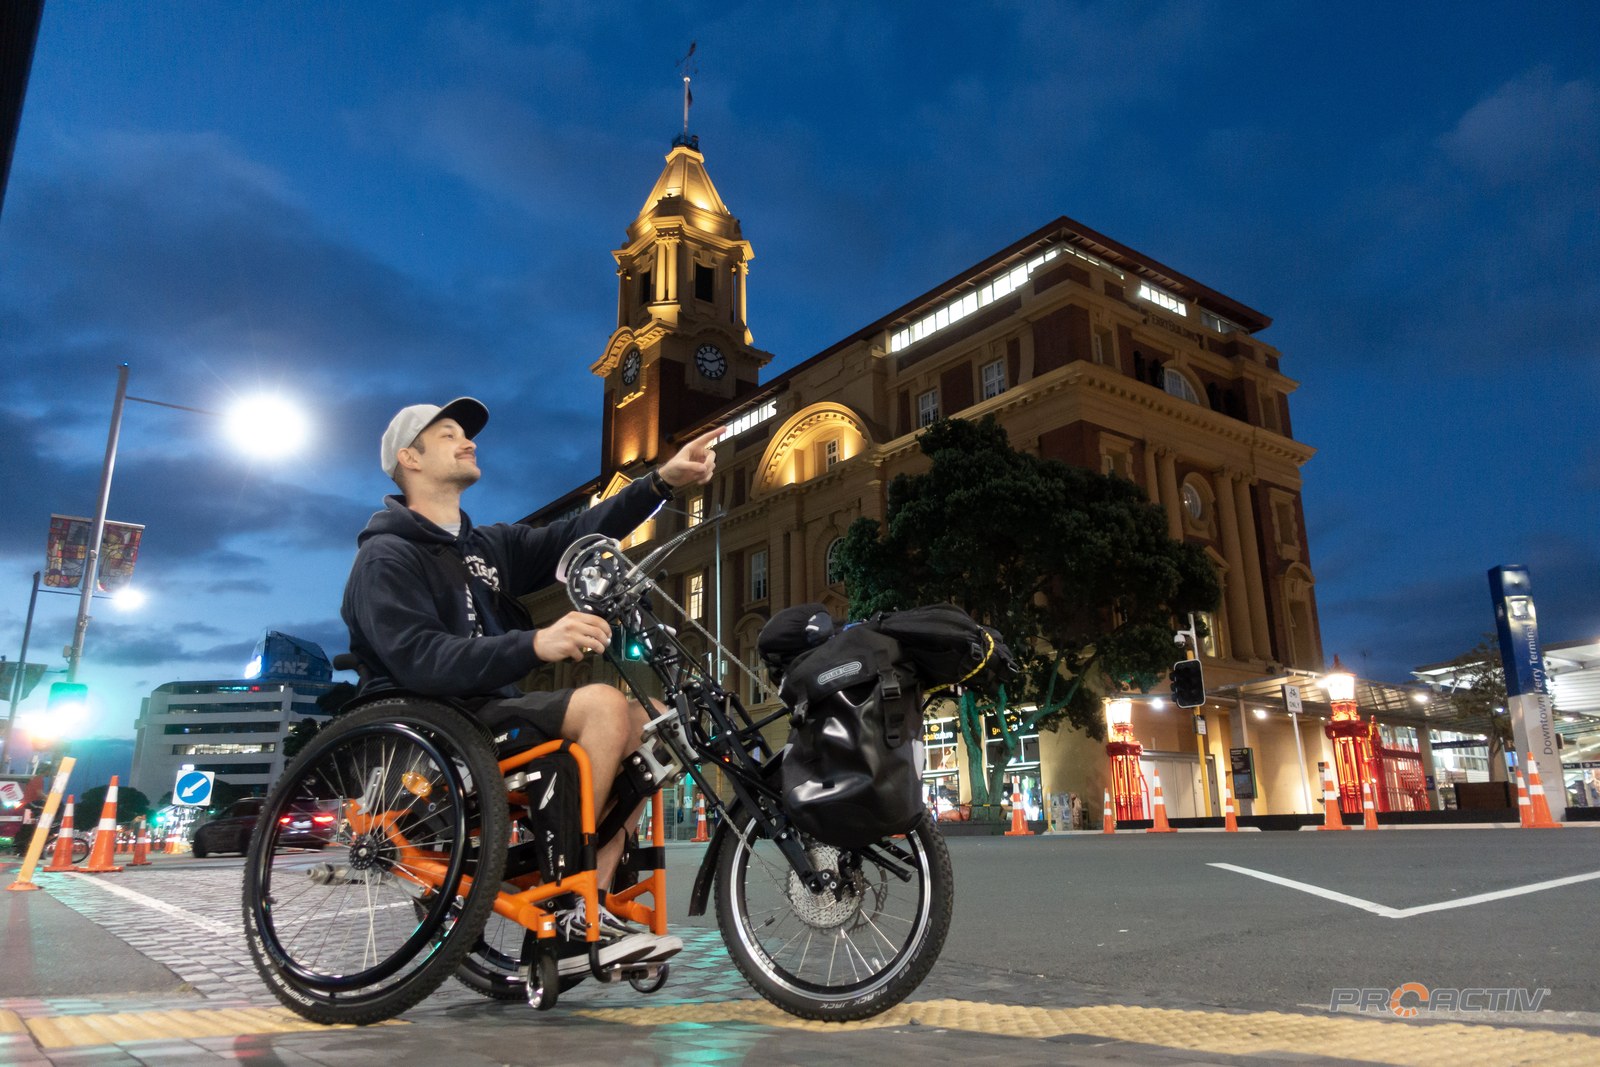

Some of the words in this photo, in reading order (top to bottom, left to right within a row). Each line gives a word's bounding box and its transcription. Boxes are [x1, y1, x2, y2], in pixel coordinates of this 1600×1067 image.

[270, 660, 309, 675] ANZ
[1534, 668, 1543, 693] Ferry
[1538, 696, 1553, 755] Downtown
